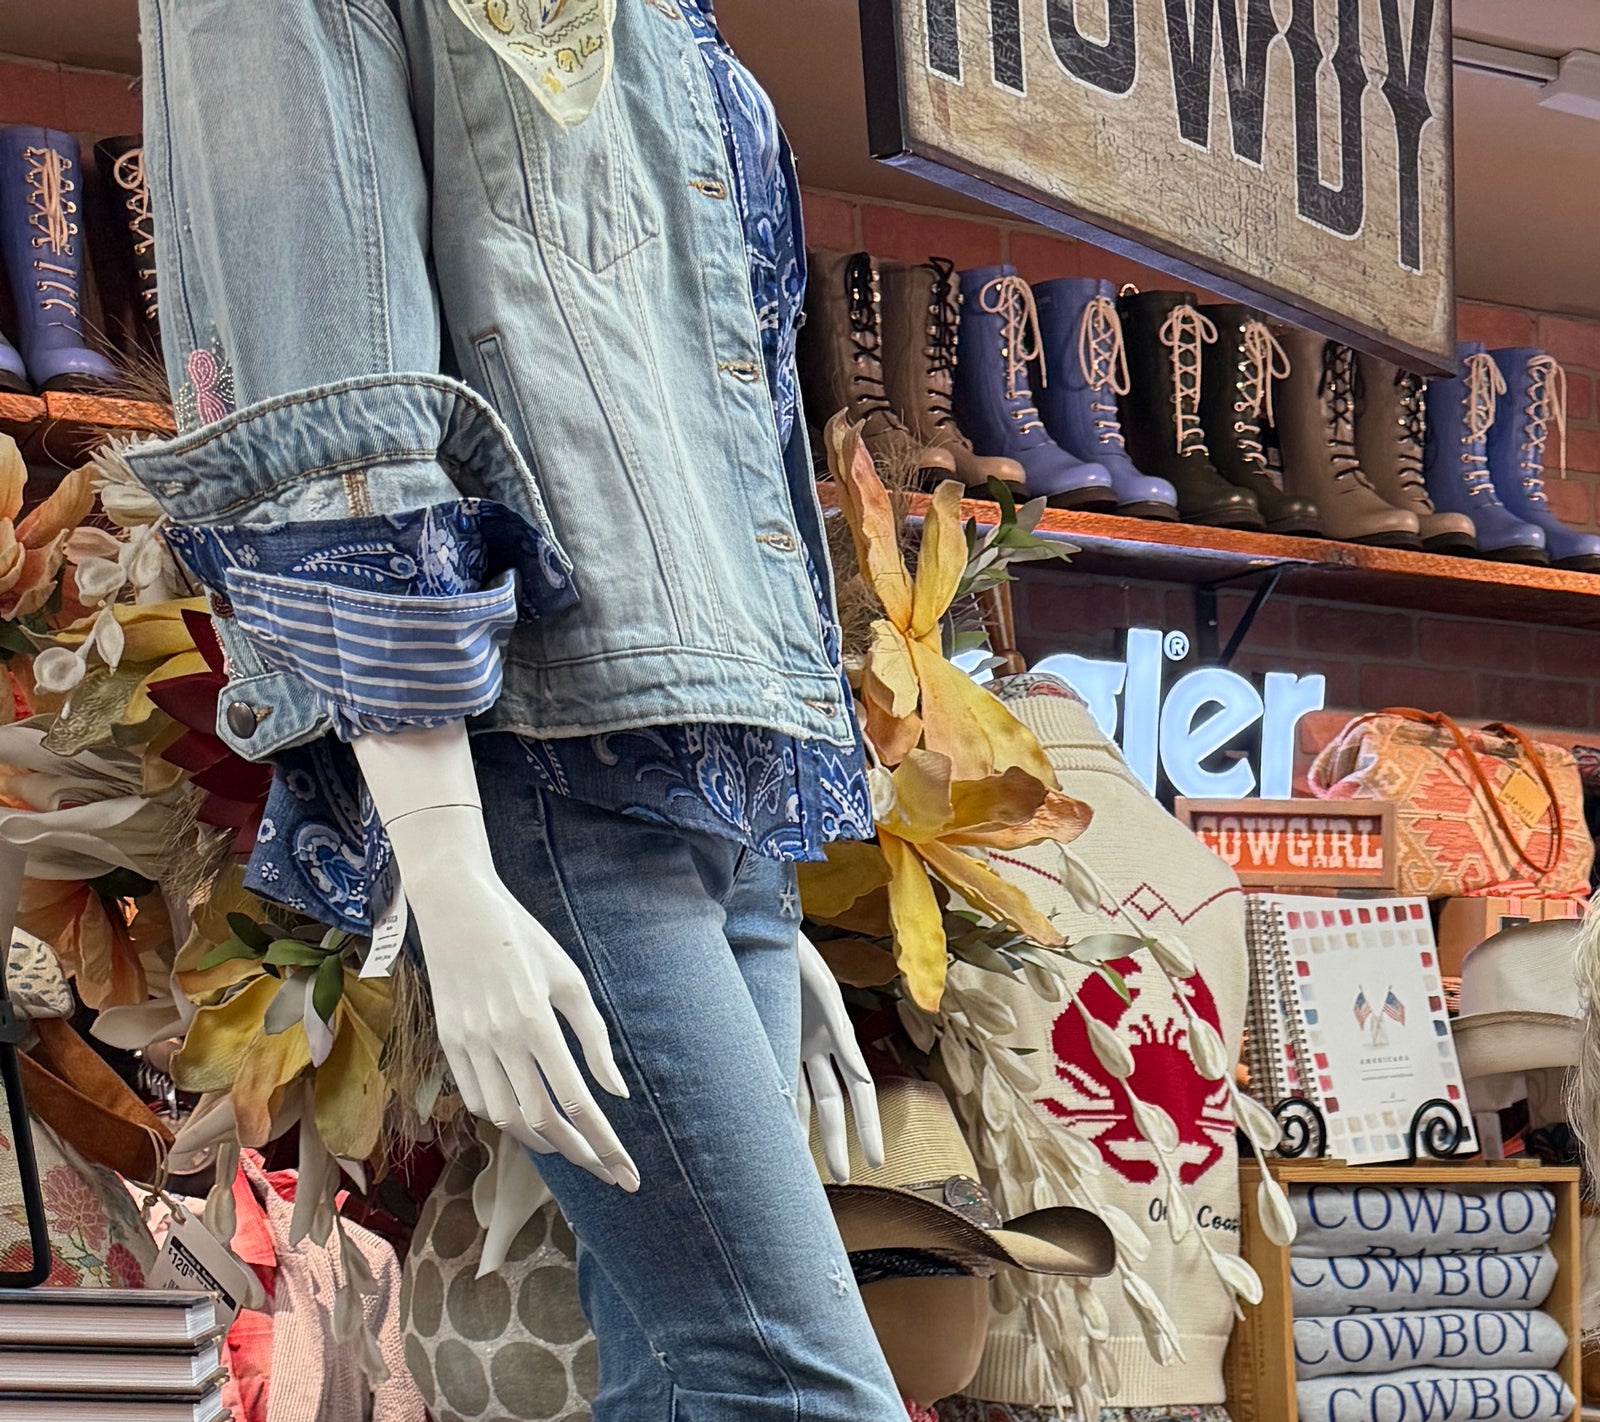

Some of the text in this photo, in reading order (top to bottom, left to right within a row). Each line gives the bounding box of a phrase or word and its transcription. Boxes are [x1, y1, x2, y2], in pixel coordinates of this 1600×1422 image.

[1198, 815, 1383, 869] COWGIRL
[1291, 1254, 1543, 1301] COWBOY
[1293, 1311, 1535, 1366] COWBOY
